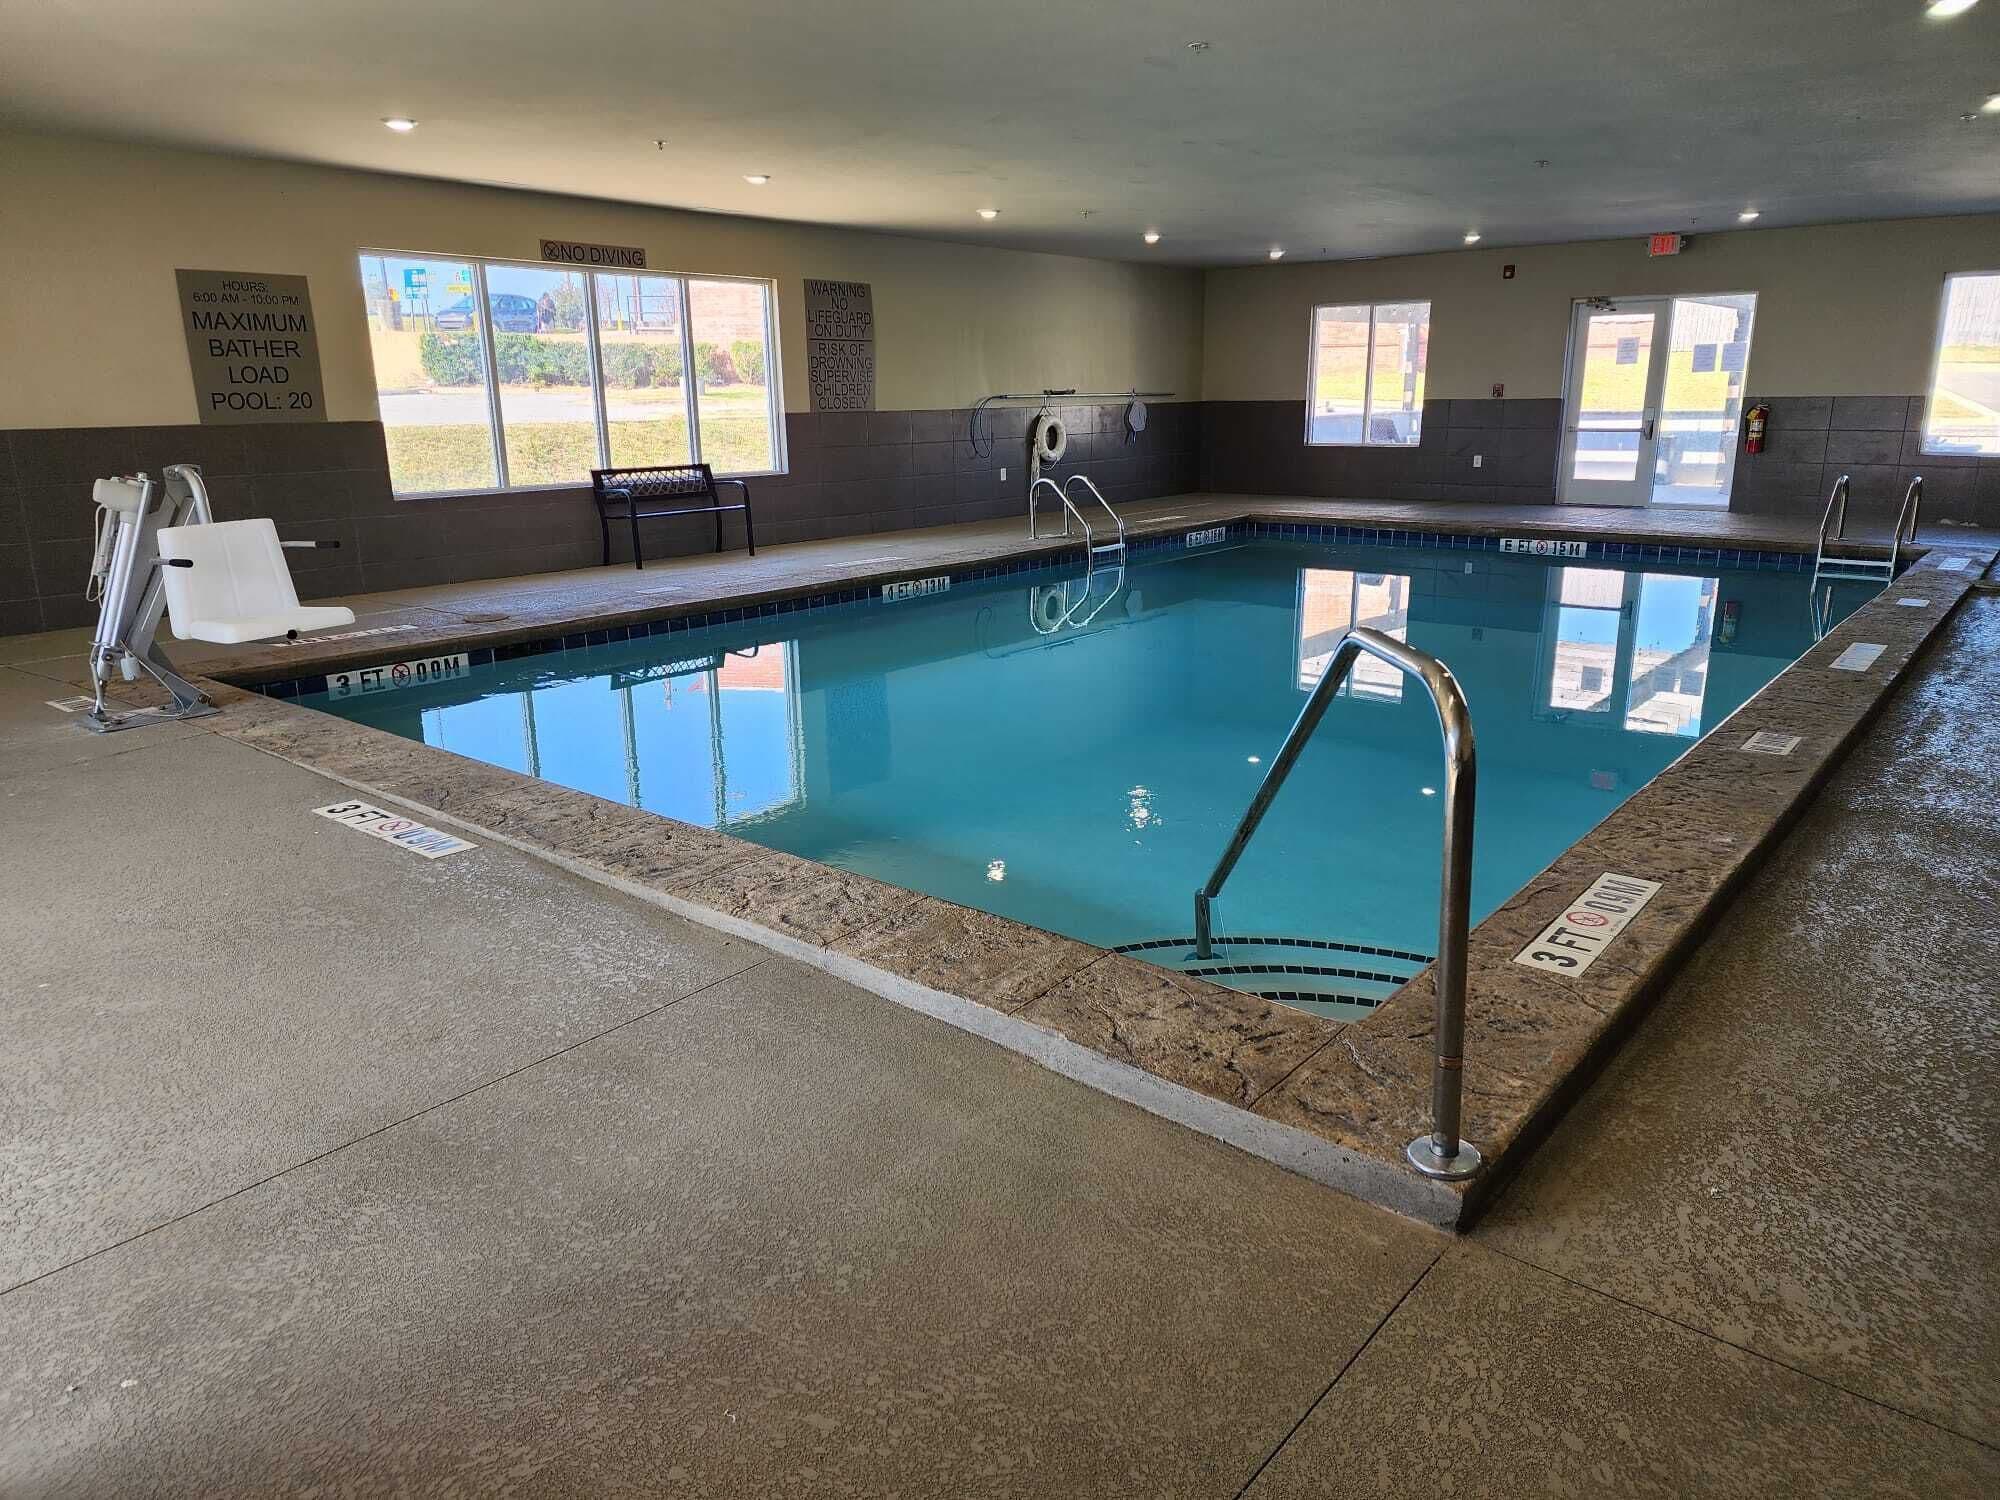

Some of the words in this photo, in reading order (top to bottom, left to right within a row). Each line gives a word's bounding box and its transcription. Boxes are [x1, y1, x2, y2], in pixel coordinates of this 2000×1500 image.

[560, 245, 585, 261] NO
[590, 247, 644, 265] DIVING
[810, 281, 865, 298] WARNING
[222, 293, 240, 304] AM
[250, 294, 279, 305] 10:00
[281, 296, 300, 306] PM
[831, 298, 848, 310] NO
[192, 311, 307, 332] MAXIMUM
[807, 310, 872, 325] LIFEGUARD
[814, 324, 832, 337] ON
[836, 325, 867, 338] DUTY
[208, 339, 301, 358] BATHER
[818, 342, 846, 356] RISK
[849, 343, 865, 356] OF
[810, 356, 873, 370] DROWNING
[228, 366, 289, 384] LOAD
[810, 370, 873, 383] SUPERVISE
[815, 383, 871, 397] CHILDREN
[211, 392, 282, 410] POOL:
[289, 392, 313, 409] 20
[818, 397, 868, 410] CLOSELY
[336, 674, 351, 696] 3
[327, 804, 361, 814] 3
[343, 810, 391, 825] FT
[1546, 926, 1601, 953] FT
[1531, 951, 1578, 968] 3
